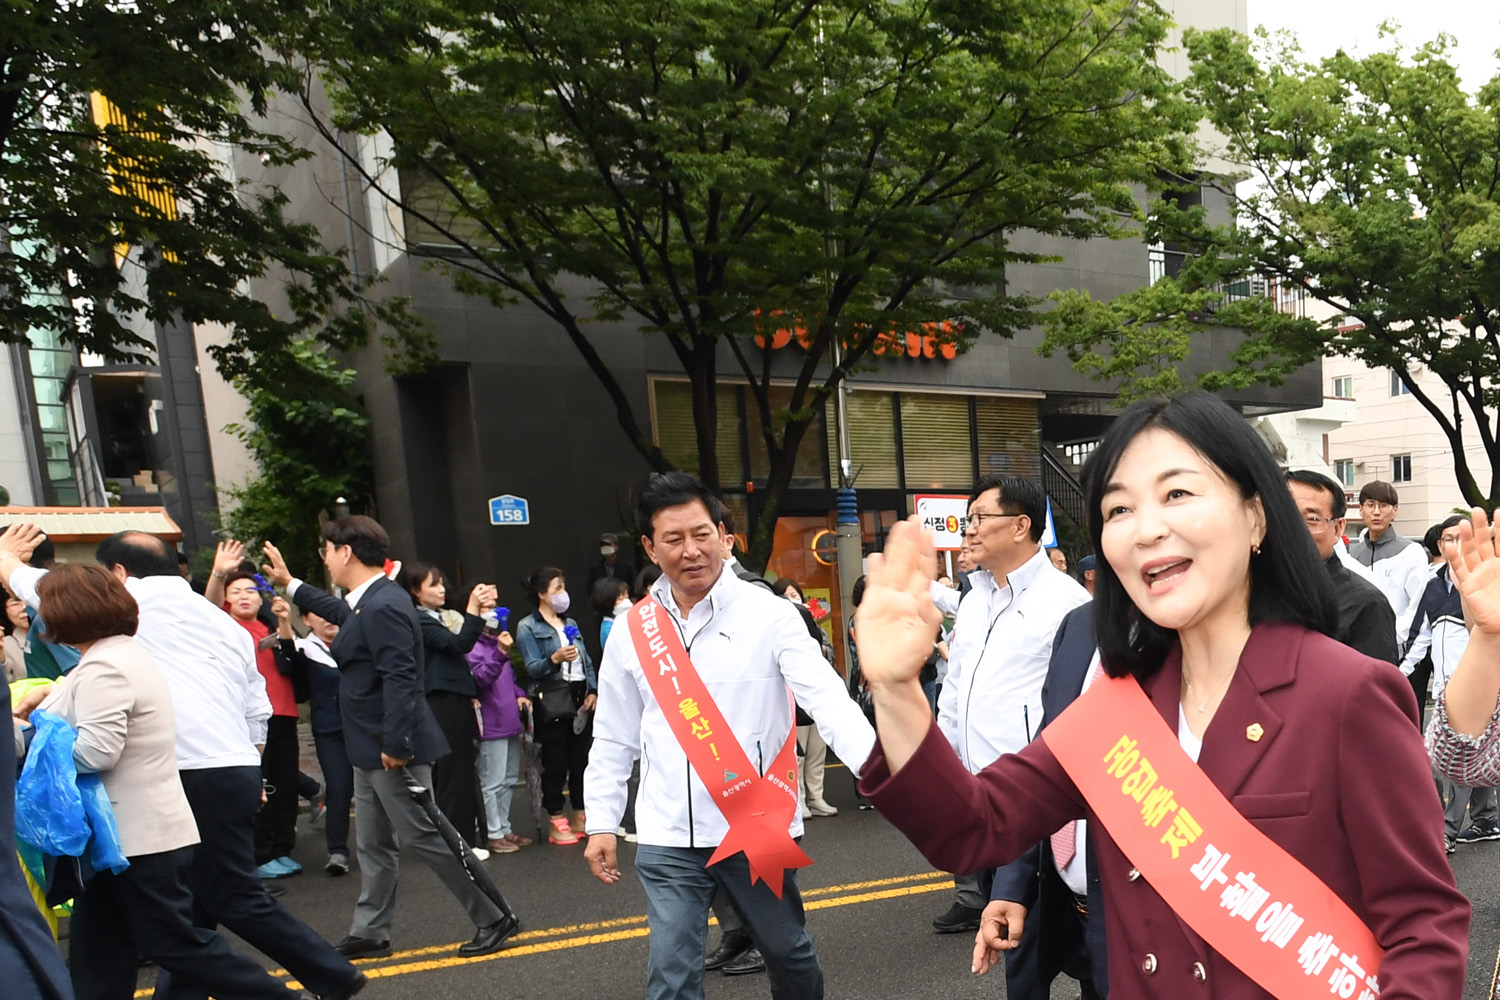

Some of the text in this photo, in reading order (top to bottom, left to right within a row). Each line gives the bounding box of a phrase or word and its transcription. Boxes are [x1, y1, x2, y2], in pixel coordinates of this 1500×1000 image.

[496, 509, 523, 521] 158
[1103, 734, 1203, 859] 공업축제
[1189, 843, 1304, 949] 부활을
